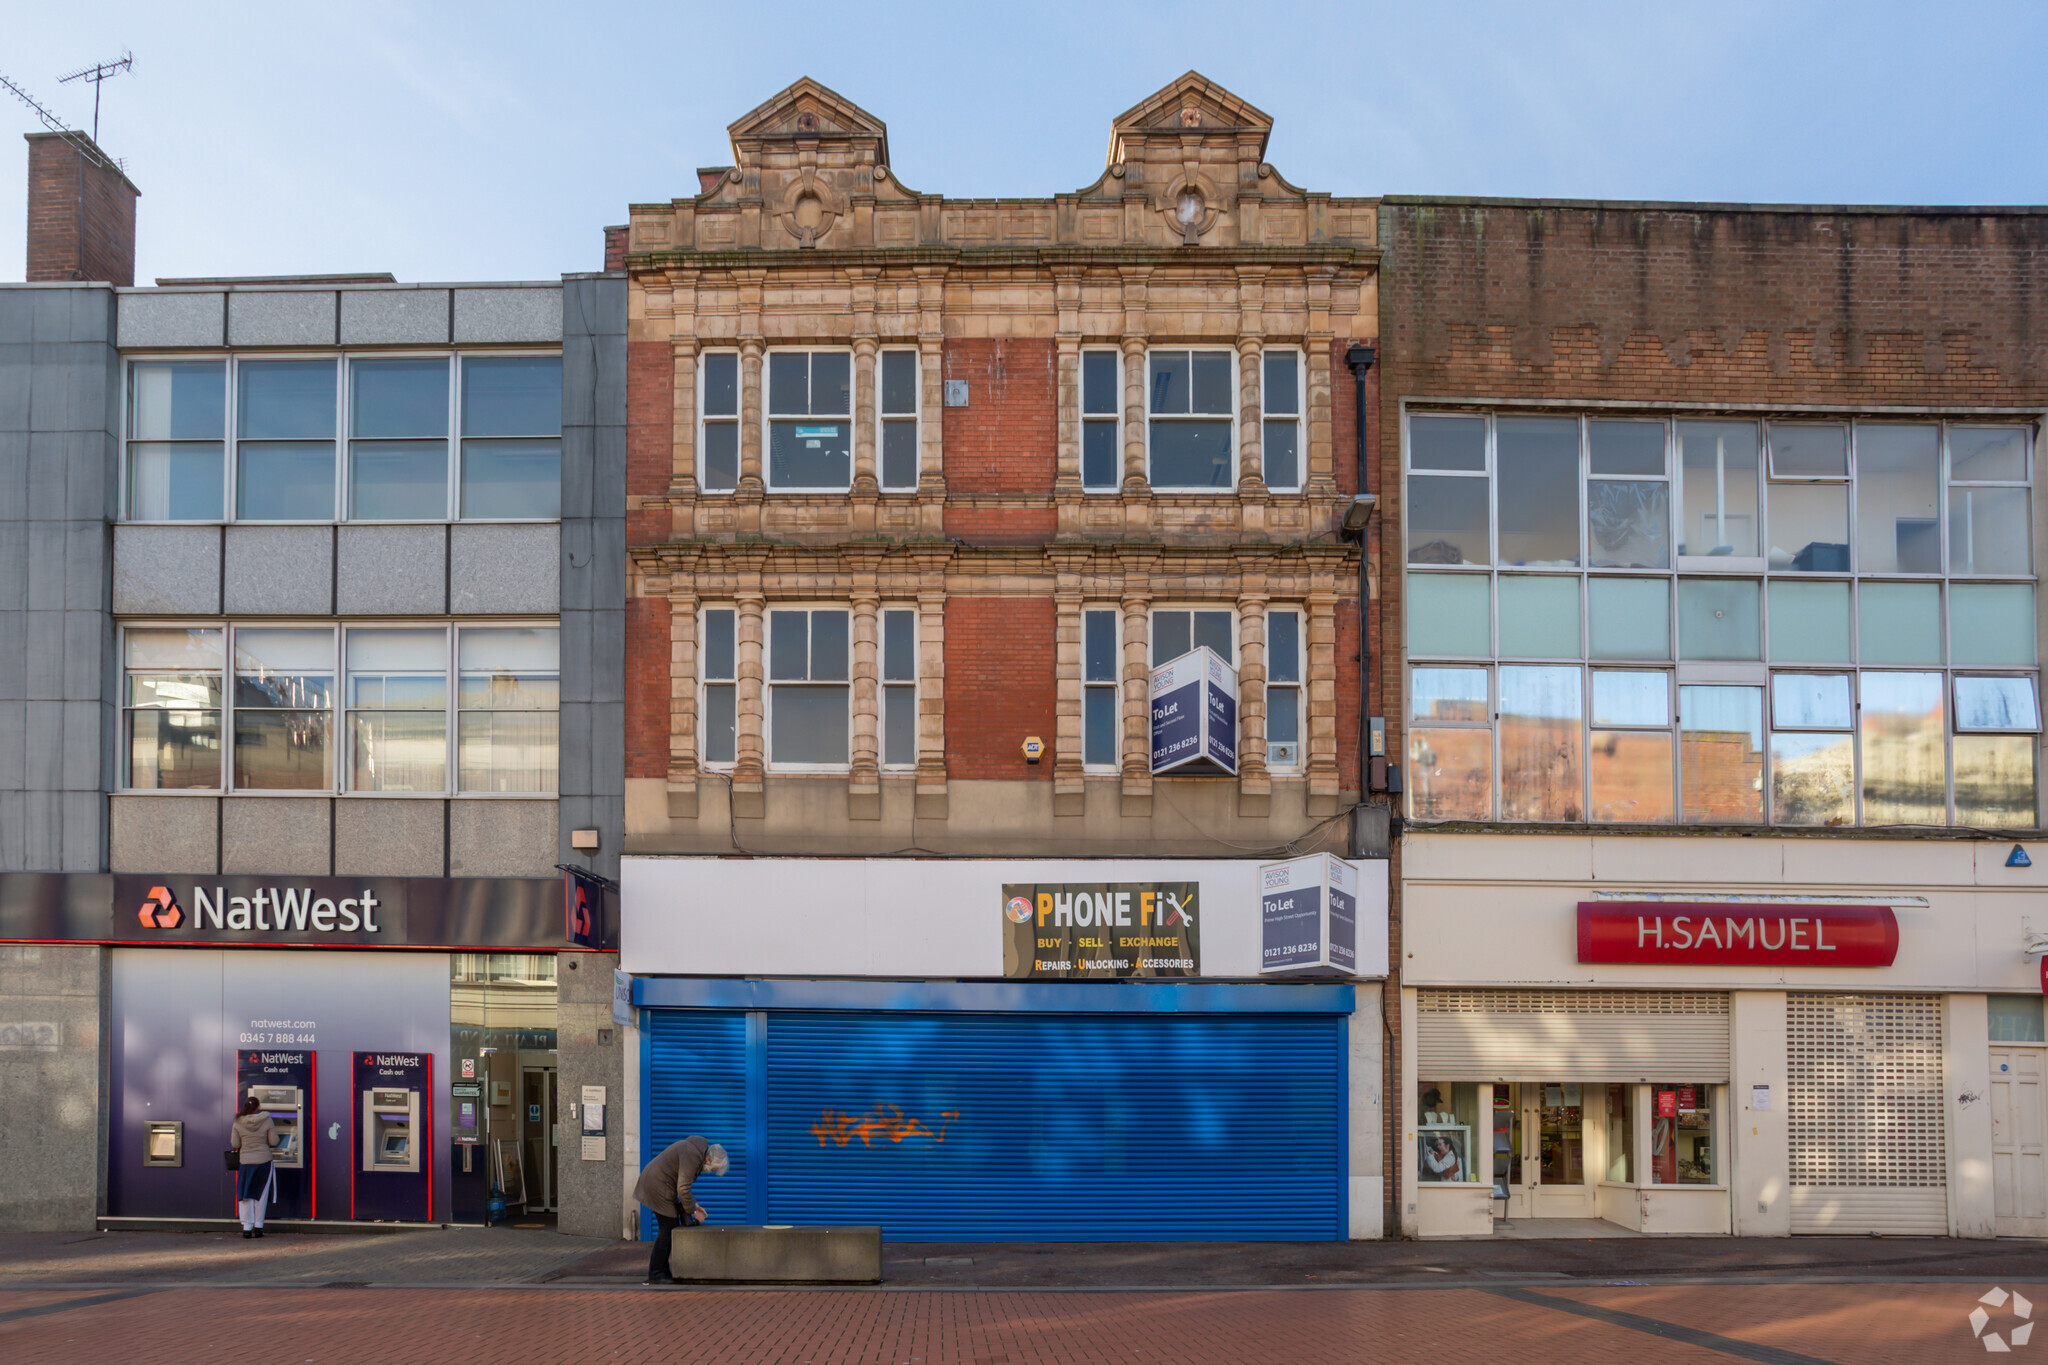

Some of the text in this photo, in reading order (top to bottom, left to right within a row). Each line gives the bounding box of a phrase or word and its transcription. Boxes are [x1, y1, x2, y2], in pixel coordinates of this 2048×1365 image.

[1153, 669, 1174, 684] AVISON
[1153, 677, 1174, 690] YOUNG
[1208, 691, 1225, 713] To Let
[1152, 701, 1178, 721] To Let
[1153, 735, 1198, 760] 0121 236 8236
[1265, 869, 1289, 880] AVISON
[1265, 877, 1289, 887] YOUNG
[1263, 898, 1294, 913] To Let
[1329, 893, 1345, 910] To Let
[194, 886, 379, 932] NatWest
[1037, 892, 1132, 927] PHONE
[1637, 916, 1837, 951] H.SAMUEL
[1037, 938, 1062, 948] BUY
[1079, 937, 1104, 948] SELL
[1119, 937, 1179, 947] EXCHANGE
[1264, 942, 1318, 957] 0121 236 8236
[1035, 959, 1072, 971] REPAIRS
[1078, 958, 1129, 970] UNLOCKING
[1135, 957, 1194, 969] ACCESSORIES
[250, 1019, 316, 1029] natwest.com
[240, 1032, 316, 1044] 0345 7 888 444
[261, 1052, 304, 1064] NatWest
[376, 1055, 419, 1067] NatWest
[379, 1068, 394, 1076] Cash
